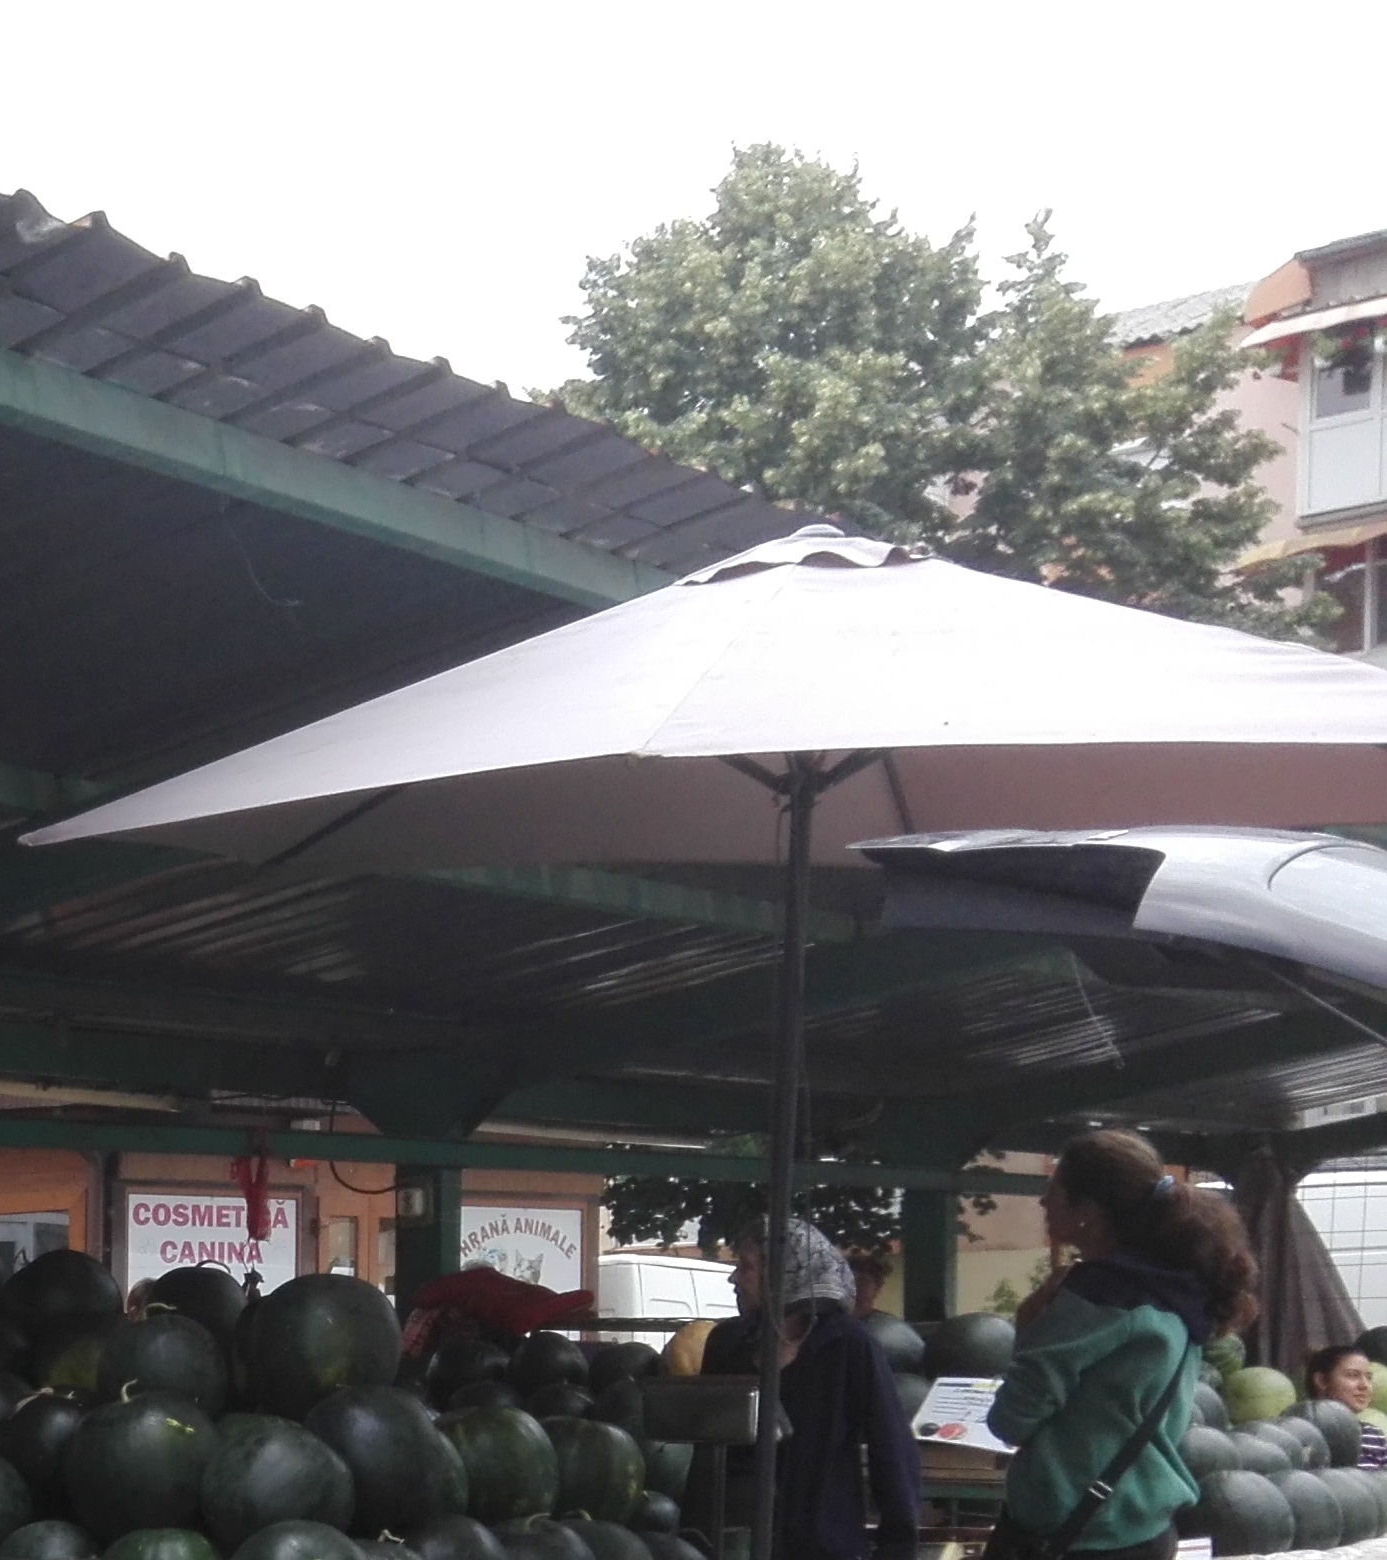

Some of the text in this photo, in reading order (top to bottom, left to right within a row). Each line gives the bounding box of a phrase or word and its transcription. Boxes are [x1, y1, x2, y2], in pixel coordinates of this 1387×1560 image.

[132, 1200, 289, 1229] COSMETĂ
[460, 1213, 577, 1260] HRANĂ ANIMALE
